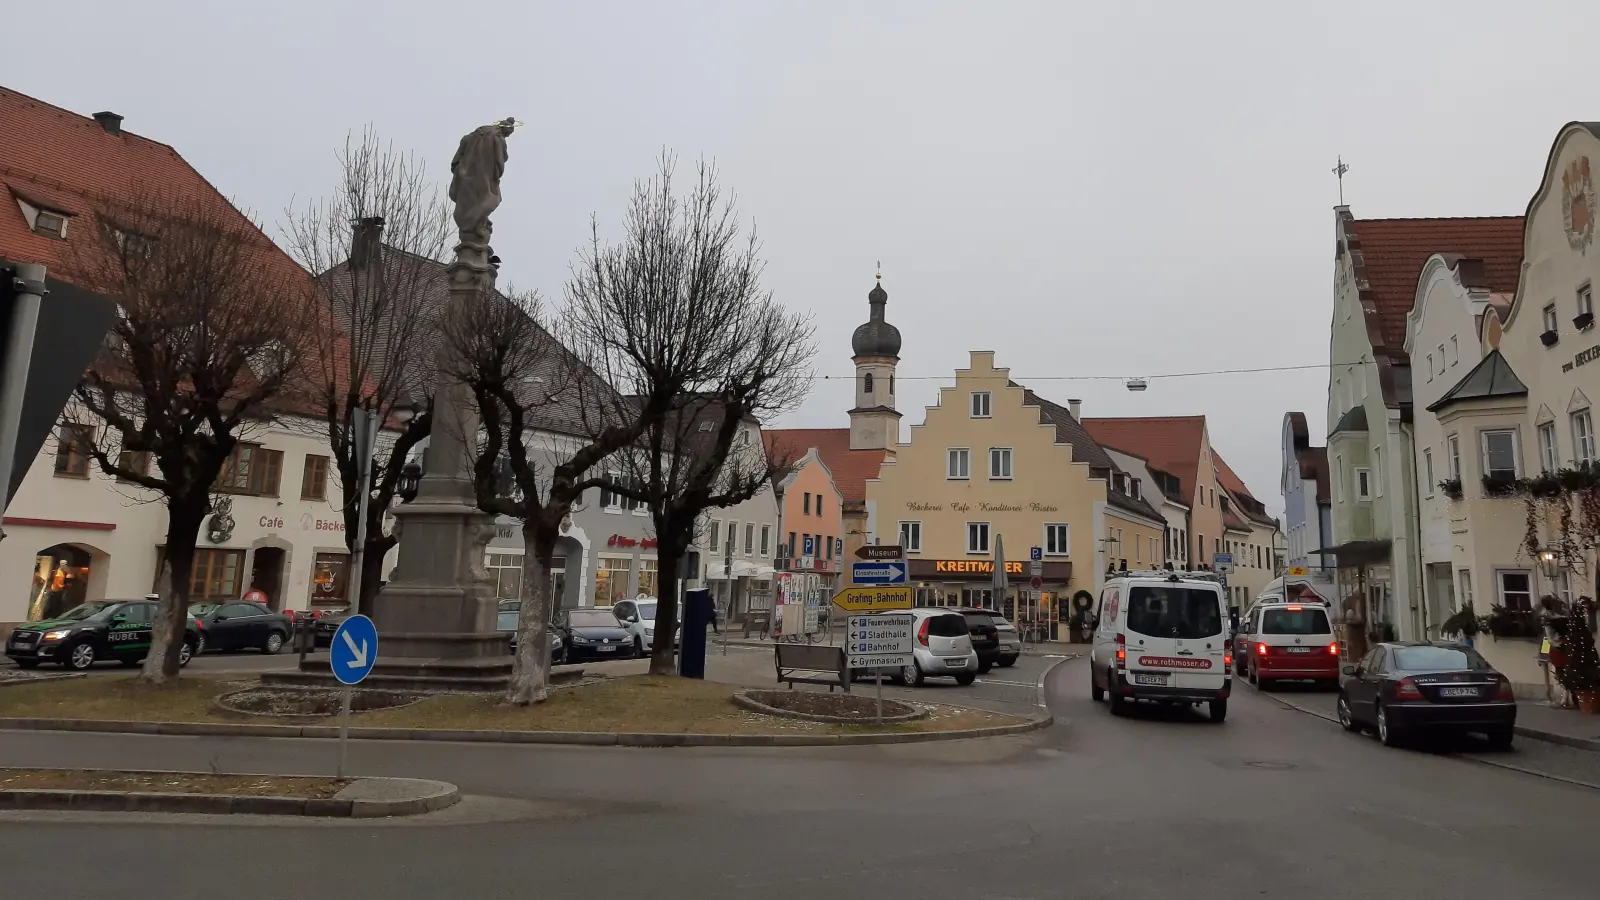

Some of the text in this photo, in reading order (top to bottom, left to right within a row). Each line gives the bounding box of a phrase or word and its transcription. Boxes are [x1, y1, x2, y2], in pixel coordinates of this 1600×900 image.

[978, 502, 1022, 512] Konditorei
[1029, 502, 1058, 512] Bistro
[259, 515, 284, 529] Café
[498, 528, 514, 539] Kids
[806, 540, 812, 552] P
[868, 549, 898, 557] Museum
[1032, 549, 1039, 558] P
[936, 561, 1023, 573] KREITMER
[847, 592, 908, 605] Grafing-Bahnhof
[867, 618, 911, 627] Feuerwehrhaus
[867, 631, 907, 639] Stadthalle
[867, 643, 900, 652] Bahnhof
[859, 657, 904, 666] Gymnasium
[1141, 658, 1209, 668] www.rothmoser.de
